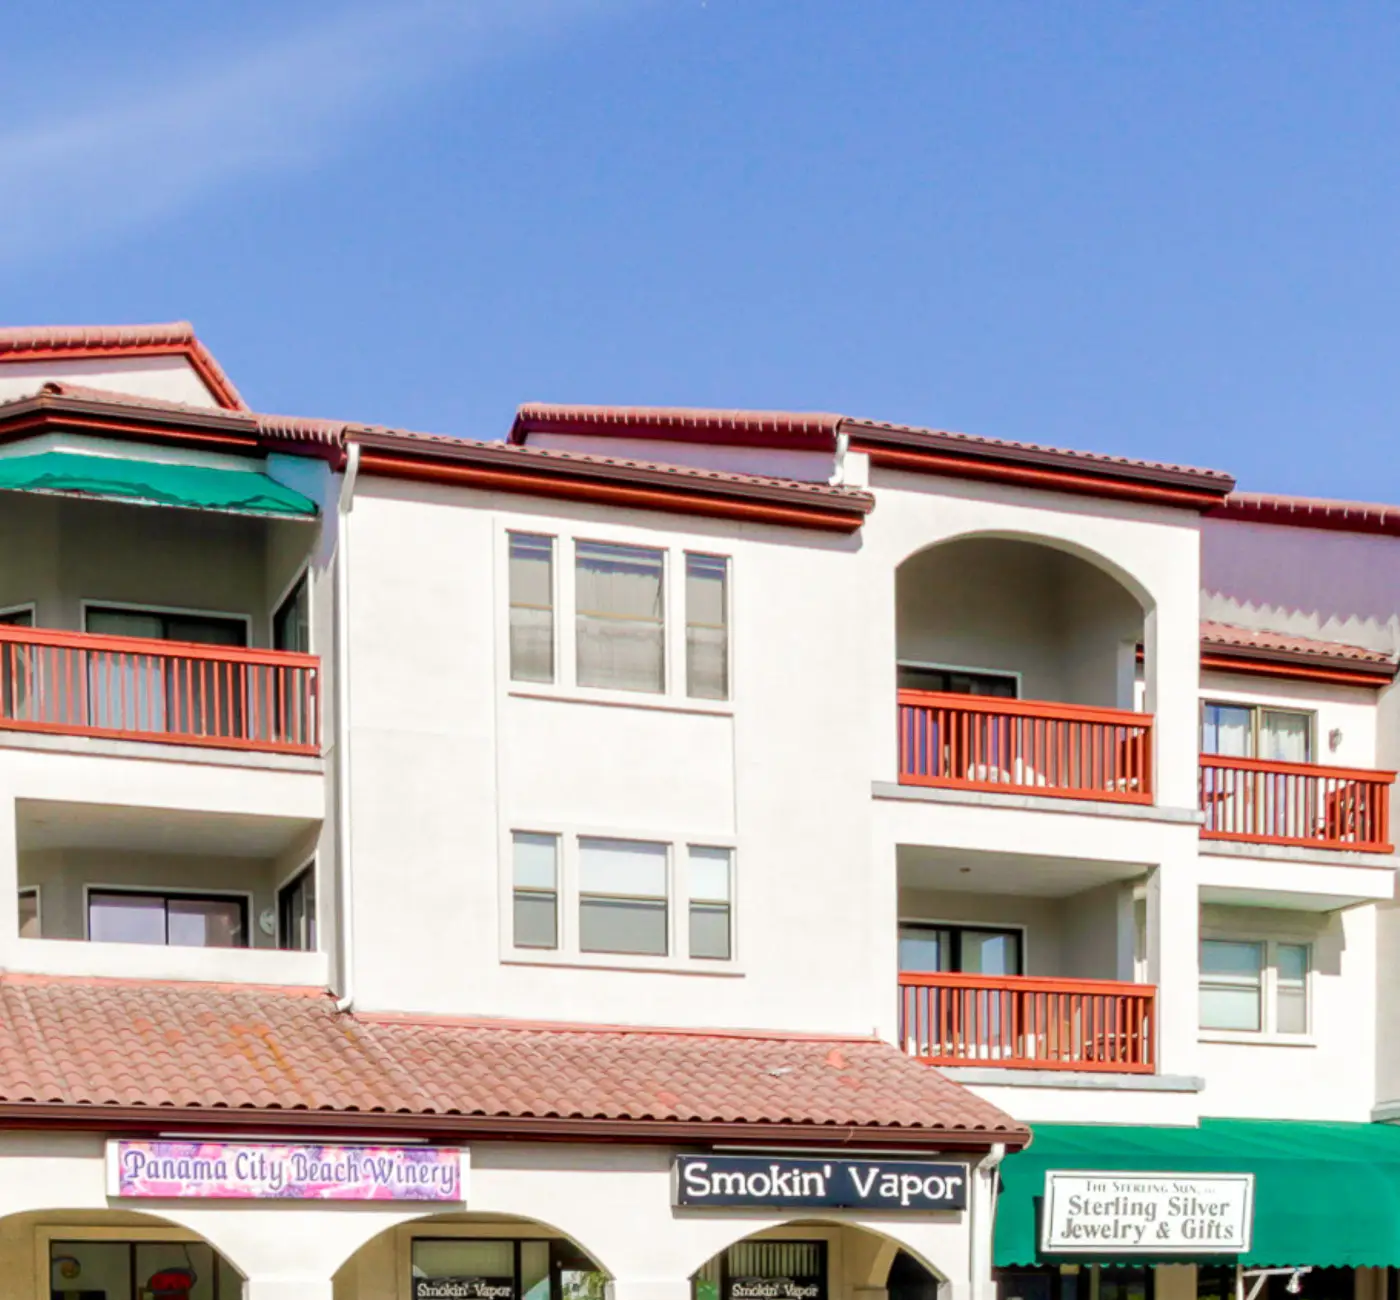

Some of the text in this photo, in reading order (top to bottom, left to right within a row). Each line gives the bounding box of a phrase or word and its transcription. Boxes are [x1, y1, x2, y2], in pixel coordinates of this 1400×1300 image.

[123, 1150, 457, 1194] Panama City Beach Winery
[684, 1162, 963, 1206] Smokin' Vapor
[1068, 1194, 1231, 1222] Sterling Silver
[1060, 1217, 1234, 1244] Jewelry & Gifts
[416, 1282, 512, 1300] Smokin' Vapor
[731, 1282, 819, 1300] Smokin' Vapor
